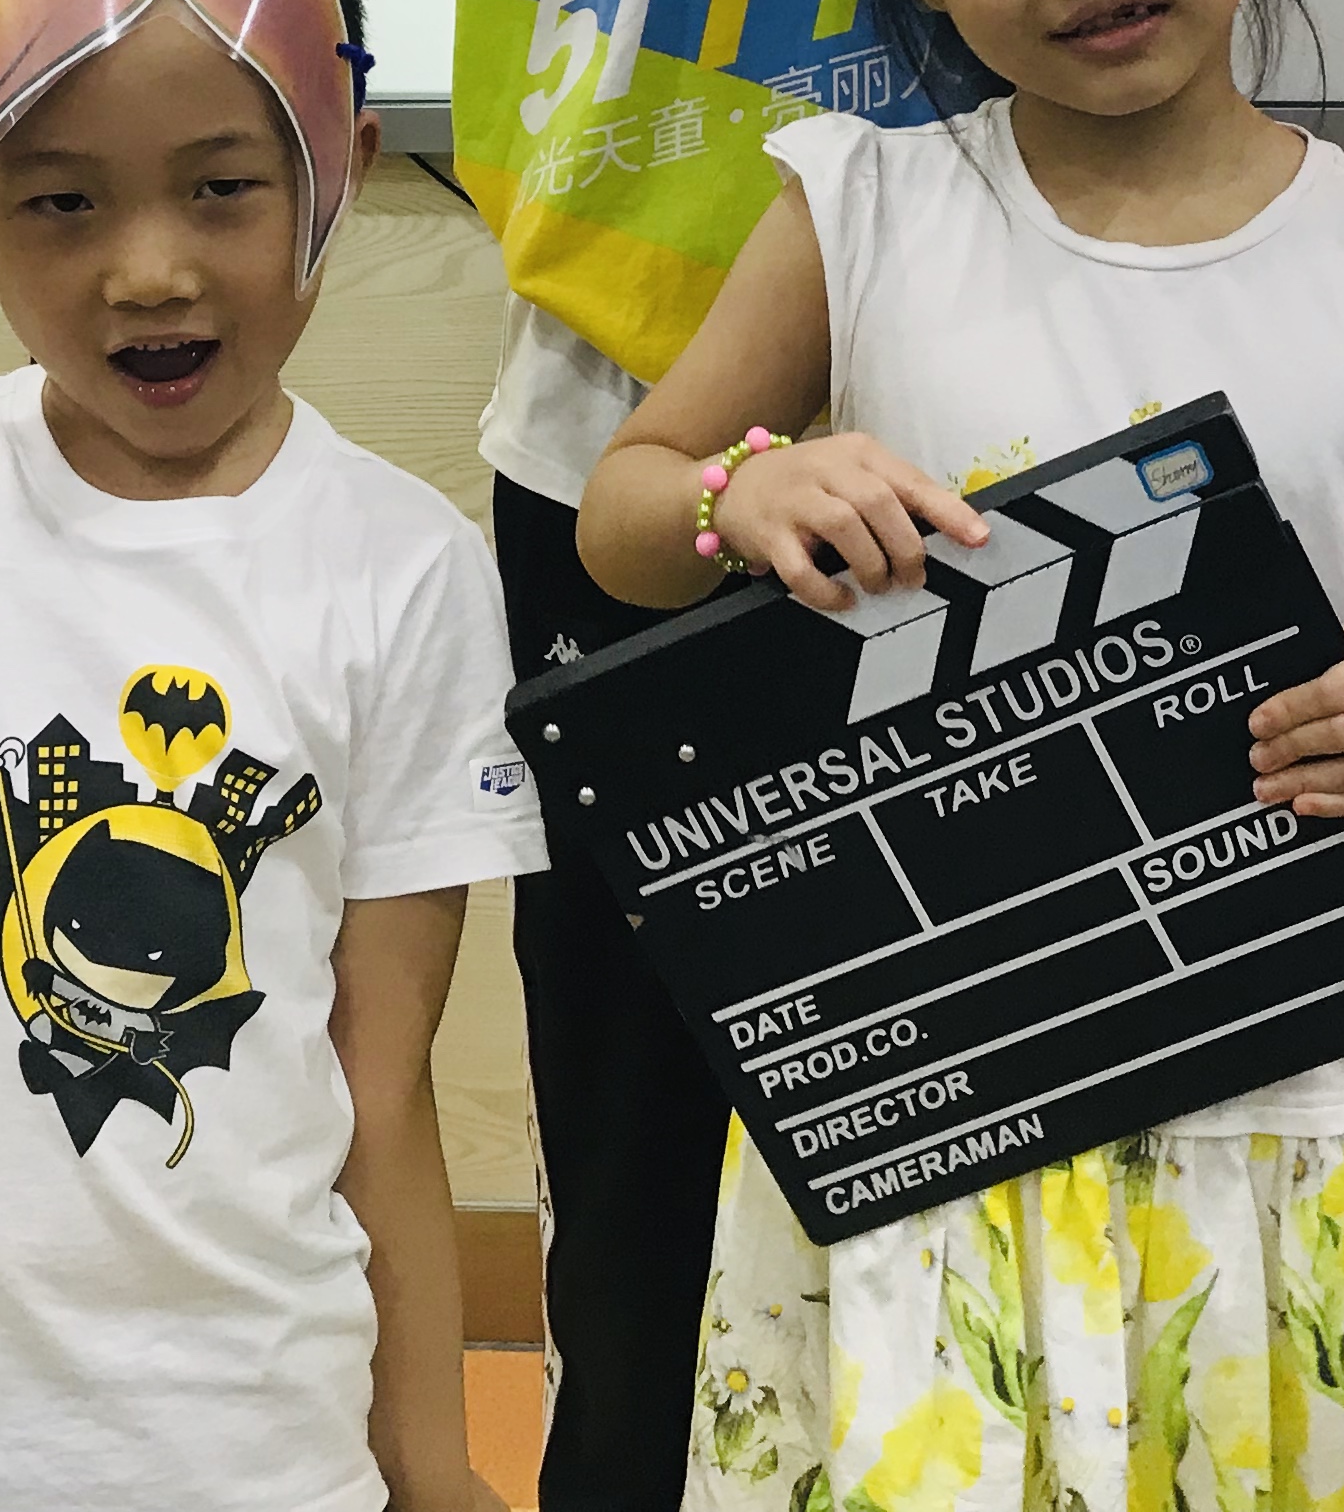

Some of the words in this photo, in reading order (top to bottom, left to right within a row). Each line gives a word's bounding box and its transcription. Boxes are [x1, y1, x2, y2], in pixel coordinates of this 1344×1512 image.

[1152, 664, 1270, 729] ROLL
[626, 726, 932, 871] UNIVERSAL
[923, 752, 1038, 818] TAKE
[694, 833, 836, 911] SCENE
[1142, 808, 1298, 892] SOUND
[728, 994, 821, 1050] DATE
[758, 1018, 929, 1099] PROD.CO.
[792, 1070, 975, 1159] DIRECTOR
[825, 1113, 1045, 1215] CAMERAMAN
